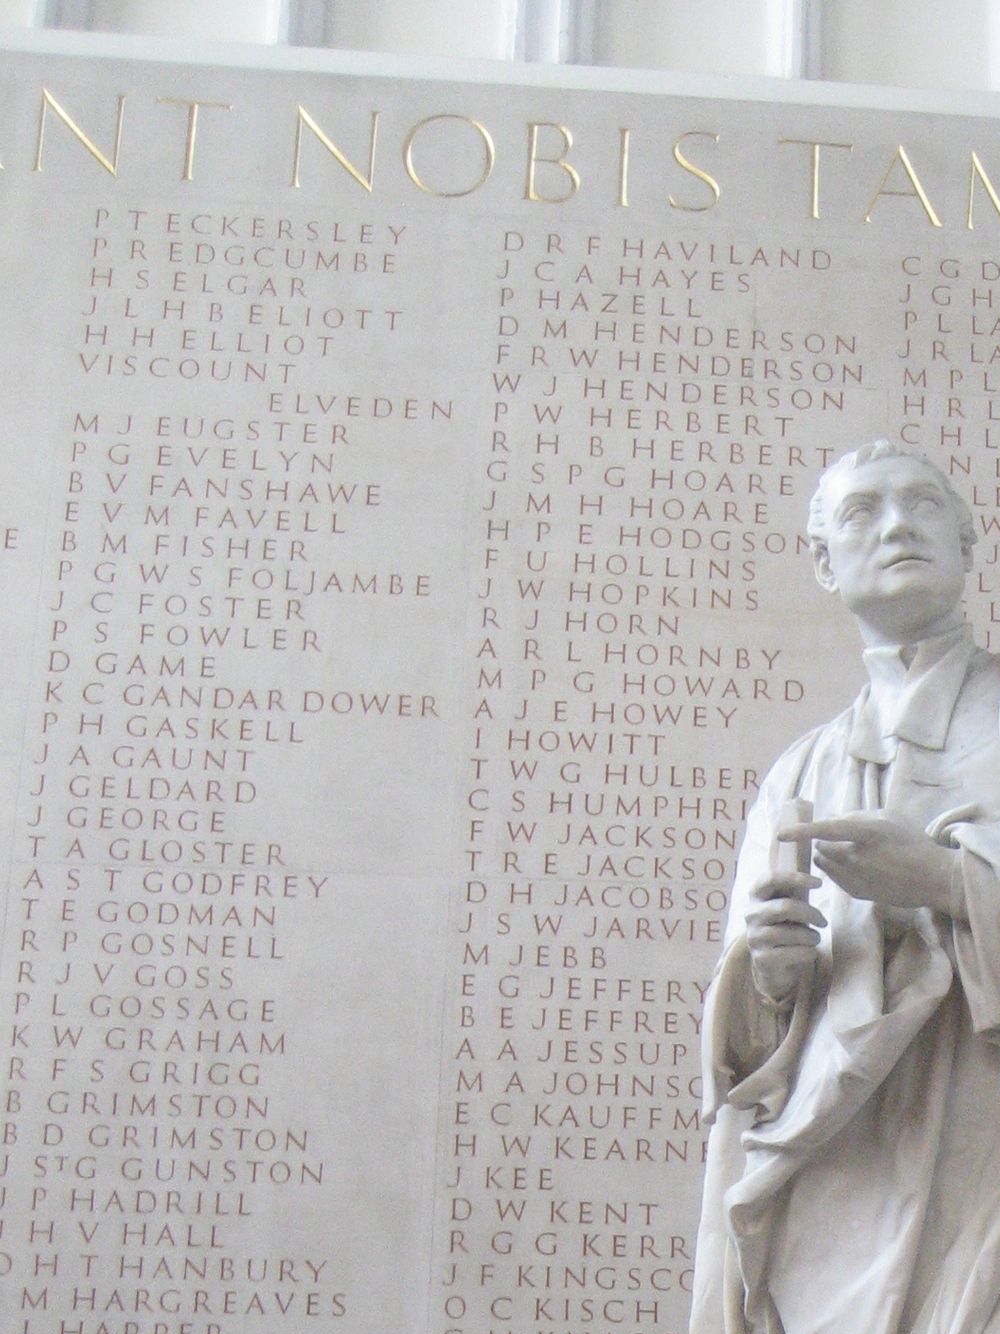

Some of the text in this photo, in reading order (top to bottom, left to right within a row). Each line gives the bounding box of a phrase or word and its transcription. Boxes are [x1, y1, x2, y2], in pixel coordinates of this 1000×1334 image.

[293, 105, 721, 213] NOBIS
[93, 207, 407, 246] P T ECKERSLEY
[88, 265, 307, 299] H S ELGAR
[497, 285, 703, 320] P HAZELL
[902, 307, 919, 332] P
[936, 312, 953, 335] L
[76, 351, 297, 385] VISCOUNT
[902, 366, 928, 389] M
[948, 367, 964, 392] P
[267, 391, 454, 422] ELVEDEN
[490, 371, 845, 413] W J HENDERSON
[902, 394, 926, 417] H
[946, 395, 967, 419] R
[493, 400, 795, 439] P W HERBERT
[898, 421, 922, 446] C
[939, 424, 963, 448] H
[67, 469, 382, 508] B V FANSHAWE
[59, 528, 309, 563] B M FISHER
[484, 546, 757, 583] F U HOLLINS
[476, 576, 760, 613] J W HOPKINS
[480, 605, 681, 637] R J HORN
[46, 648, 216, 680] D GAME
[41, 709, 305, 745] P H GASKELL
[474, 726, 667, 757] I HOWITT
[28, 773, 258, 805] J GELDARD
[26, 834, 288, 868] T A GLOSTER
[468, 818, 738, 852] F W JACKSON
[461, 941, 608, 971] M JEBB
[12, 990, 276, 1024] P L GOSSAGE
[444, 1164, 555, 1192] J KEE
[448, 1196, 661, 1228] D W KENT
